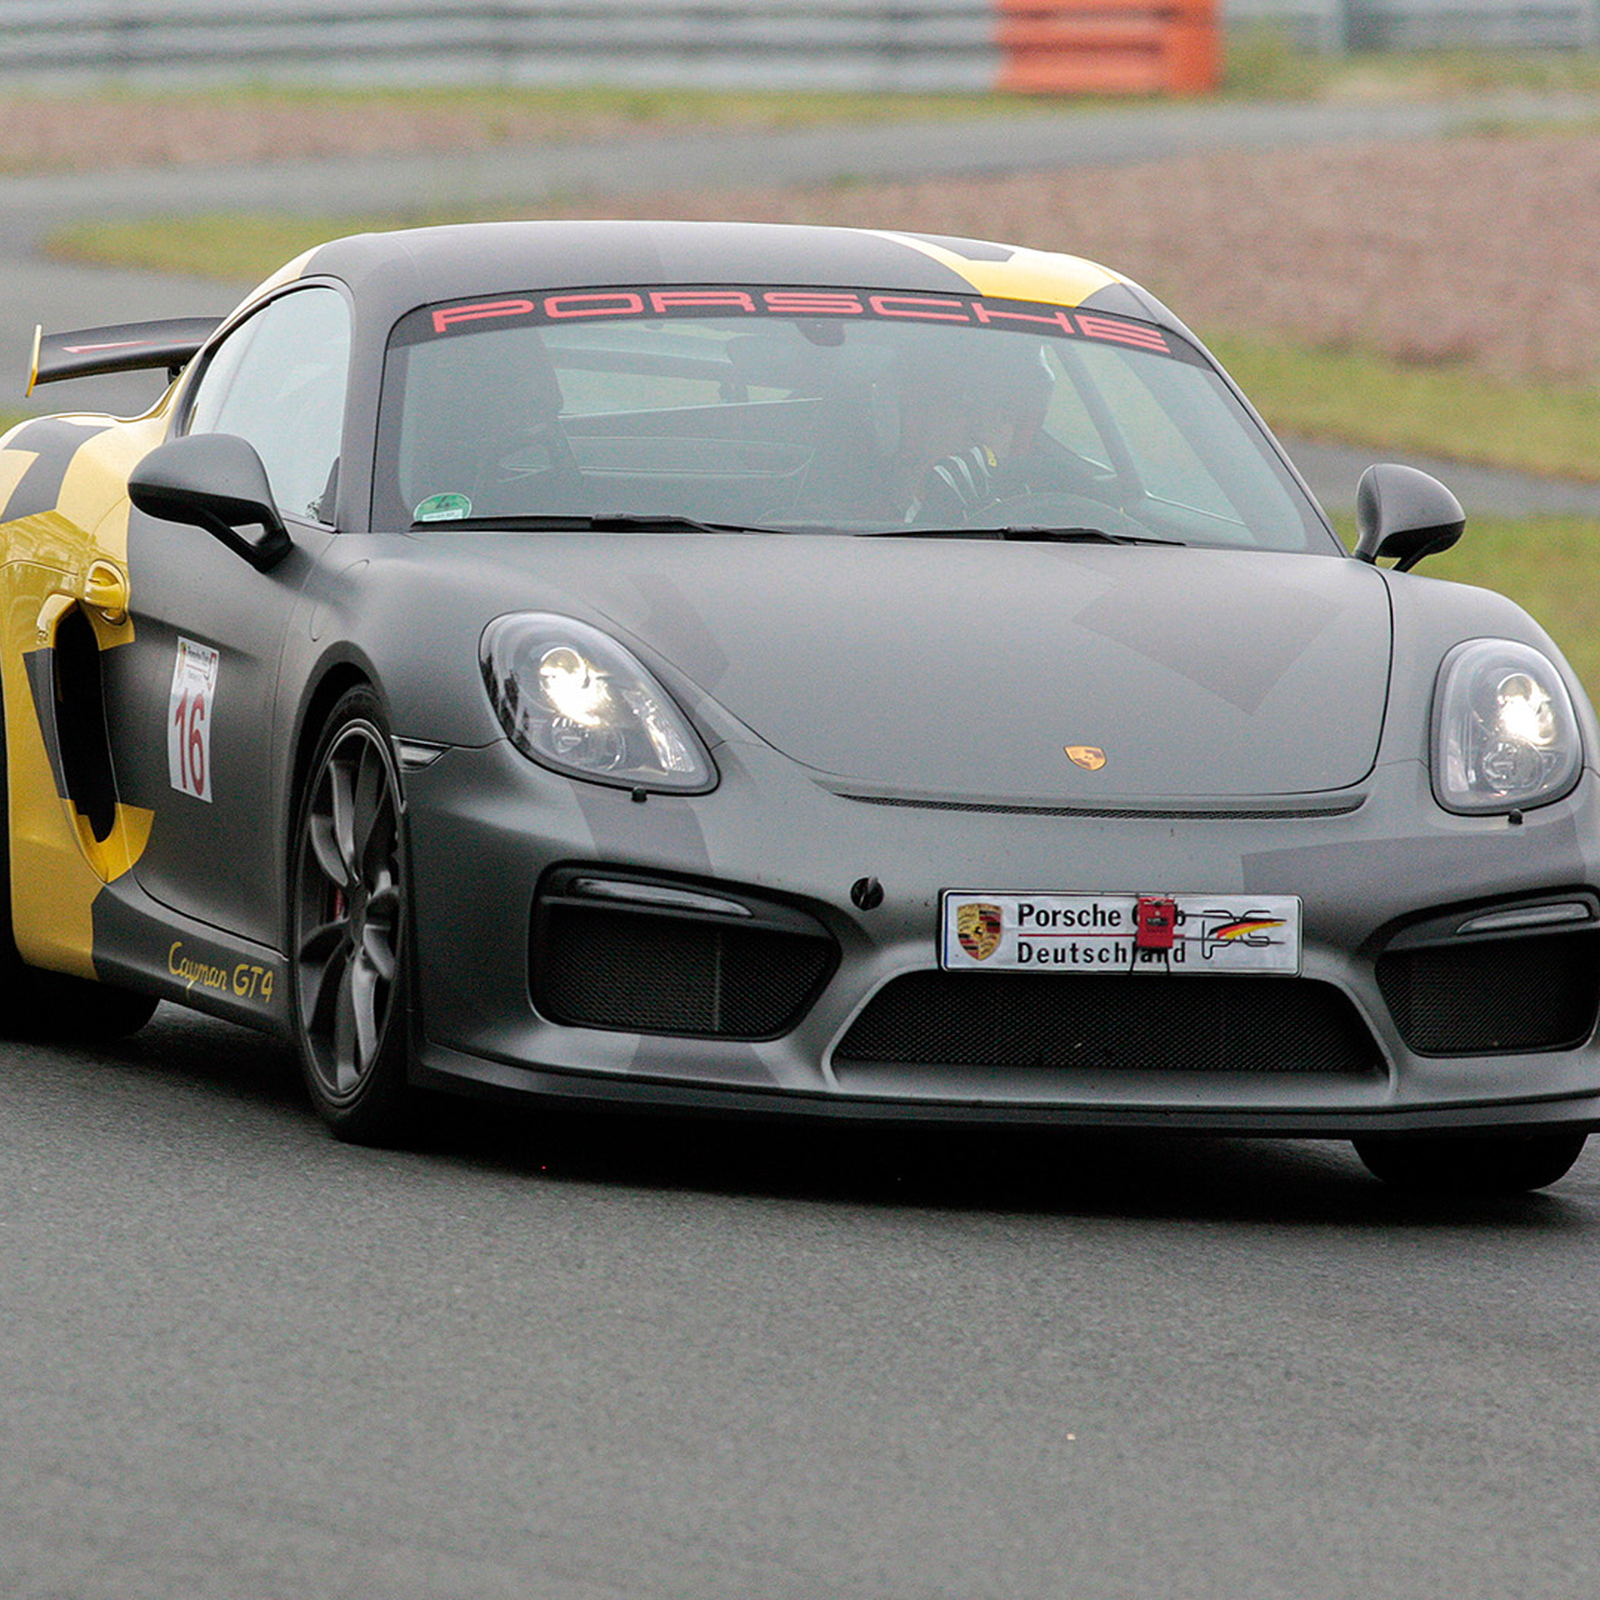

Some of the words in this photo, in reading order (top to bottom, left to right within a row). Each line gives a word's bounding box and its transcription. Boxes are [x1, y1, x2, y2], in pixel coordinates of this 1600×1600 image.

[432, 291, 1171, 354] PORSCHE
[175, 687, 206, 796] 16
[1018, 903, 1122, 927] Porsche
[168, 941, 227, 991] Cayman
[233, 964, 274, 1003] GT4
